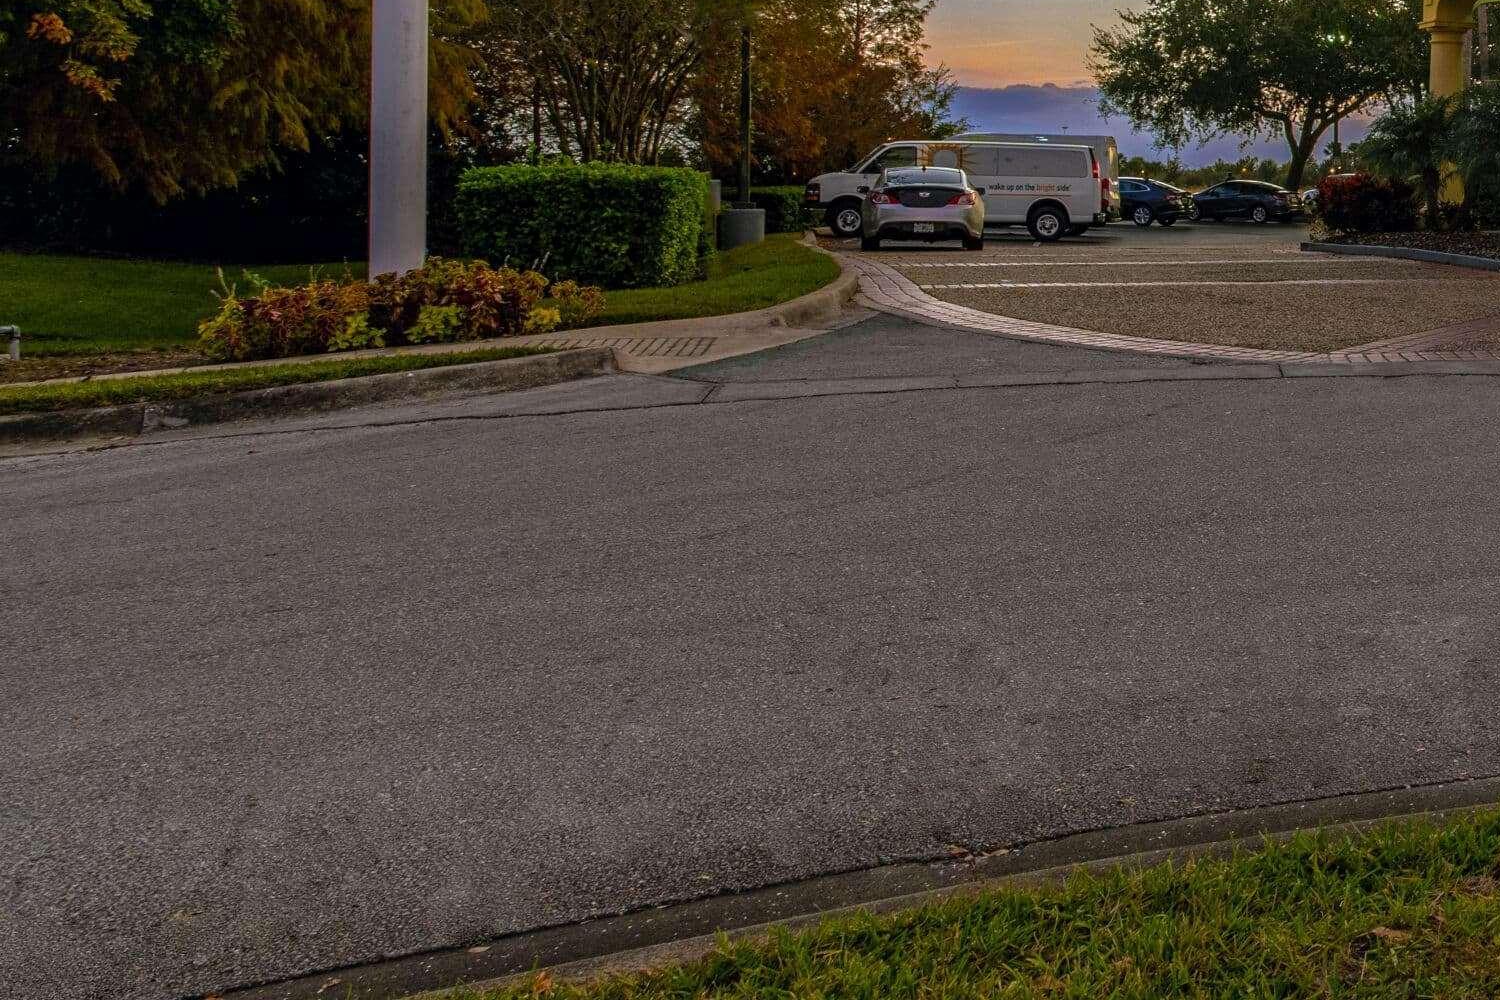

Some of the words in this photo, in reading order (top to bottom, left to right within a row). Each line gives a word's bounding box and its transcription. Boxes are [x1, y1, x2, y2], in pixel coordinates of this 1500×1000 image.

[1007, 184, 1015, 193] up
[1016, 184, 1024, 192] on
[1024, 183, 1035, 192] the
[1037, 183, 1055, 193] bright
